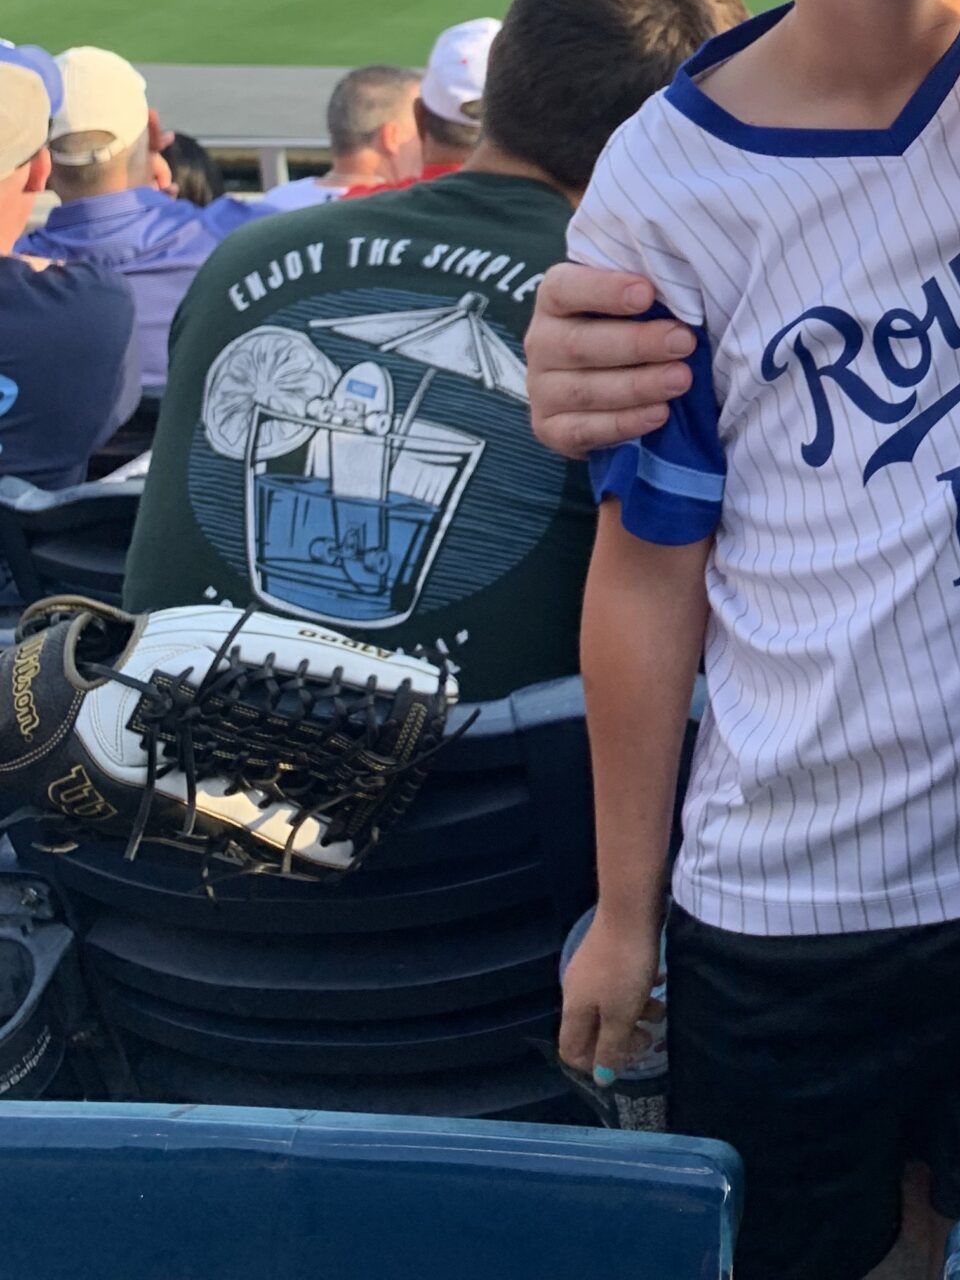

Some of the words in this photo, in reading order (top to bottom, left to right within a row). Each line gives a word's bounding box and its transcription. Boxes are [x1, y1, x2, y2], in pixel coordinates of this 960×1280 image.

[229, 242, 324, 312] ENJOY
[349, 237, 411, 267] THE
[423, 243, 545, 302] SIMPLE
